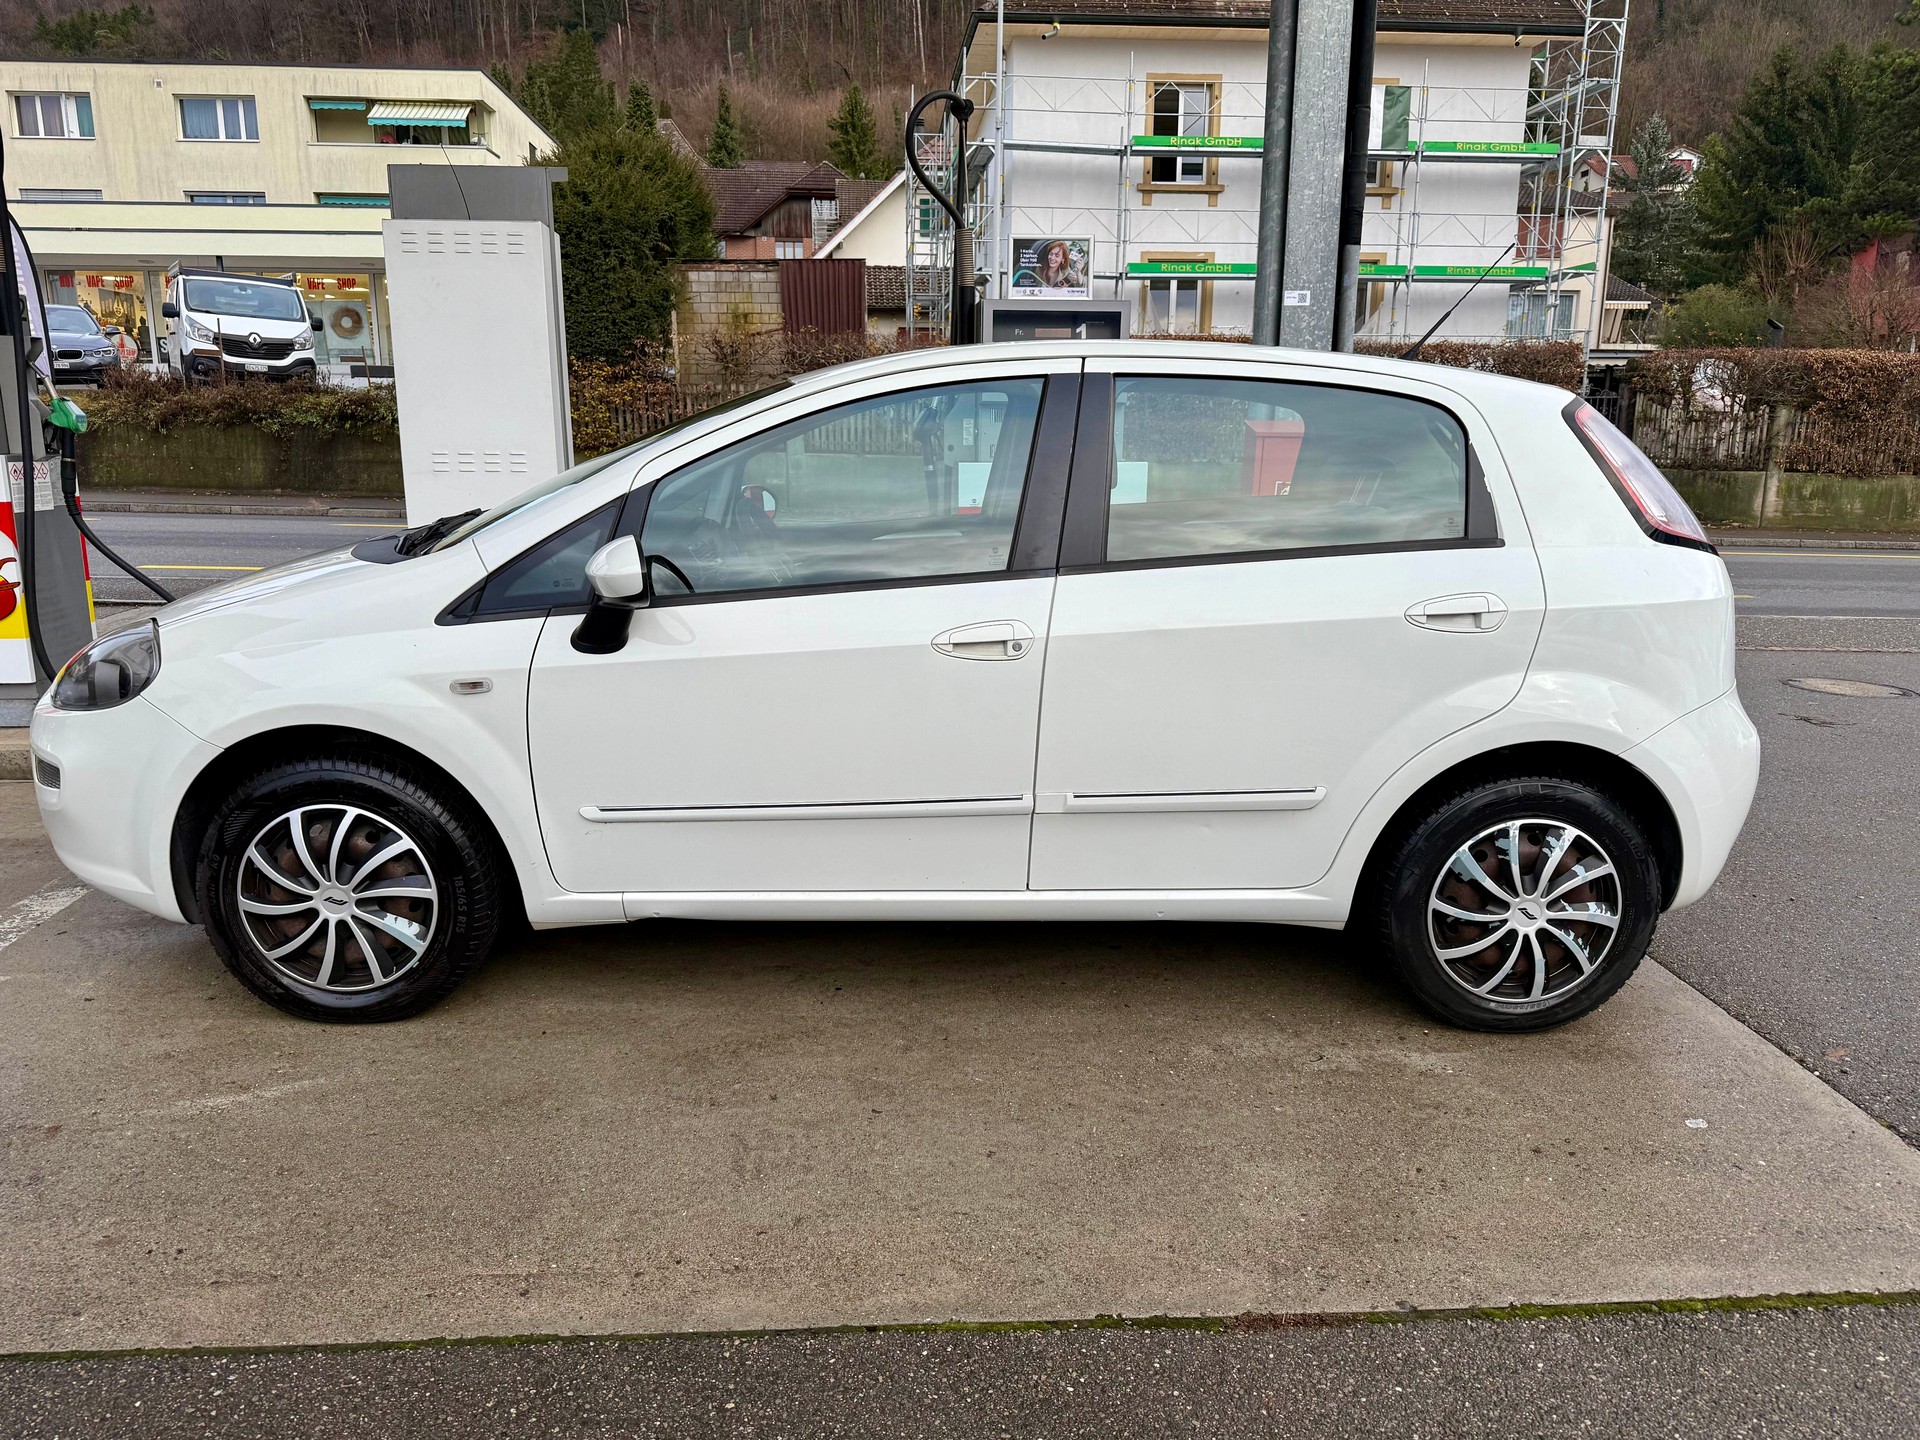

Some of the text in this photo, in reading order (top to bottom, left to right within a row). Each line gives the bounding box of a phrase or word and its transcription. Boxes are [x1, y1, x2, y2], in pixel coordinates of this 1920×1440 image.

[1170, 137, 1242, 146] Rinak GmbH
[1456, 143, 1526, 152] Rinak GmbH
[1161, 264, 1232, 272] Rinak GmbH
[1359, 264, 1375, 273] bH
[1446, 266, 1516, 275] Rinak GmbH
[86, 275, 105, 288] VAPE
[115, 275, 134, 289] SHOP
[307, 278, 356, 290] VAPE SHOP
[1075, 323, 1087, 339] 1
[453, 875, 467, 933] 185/65 R15
